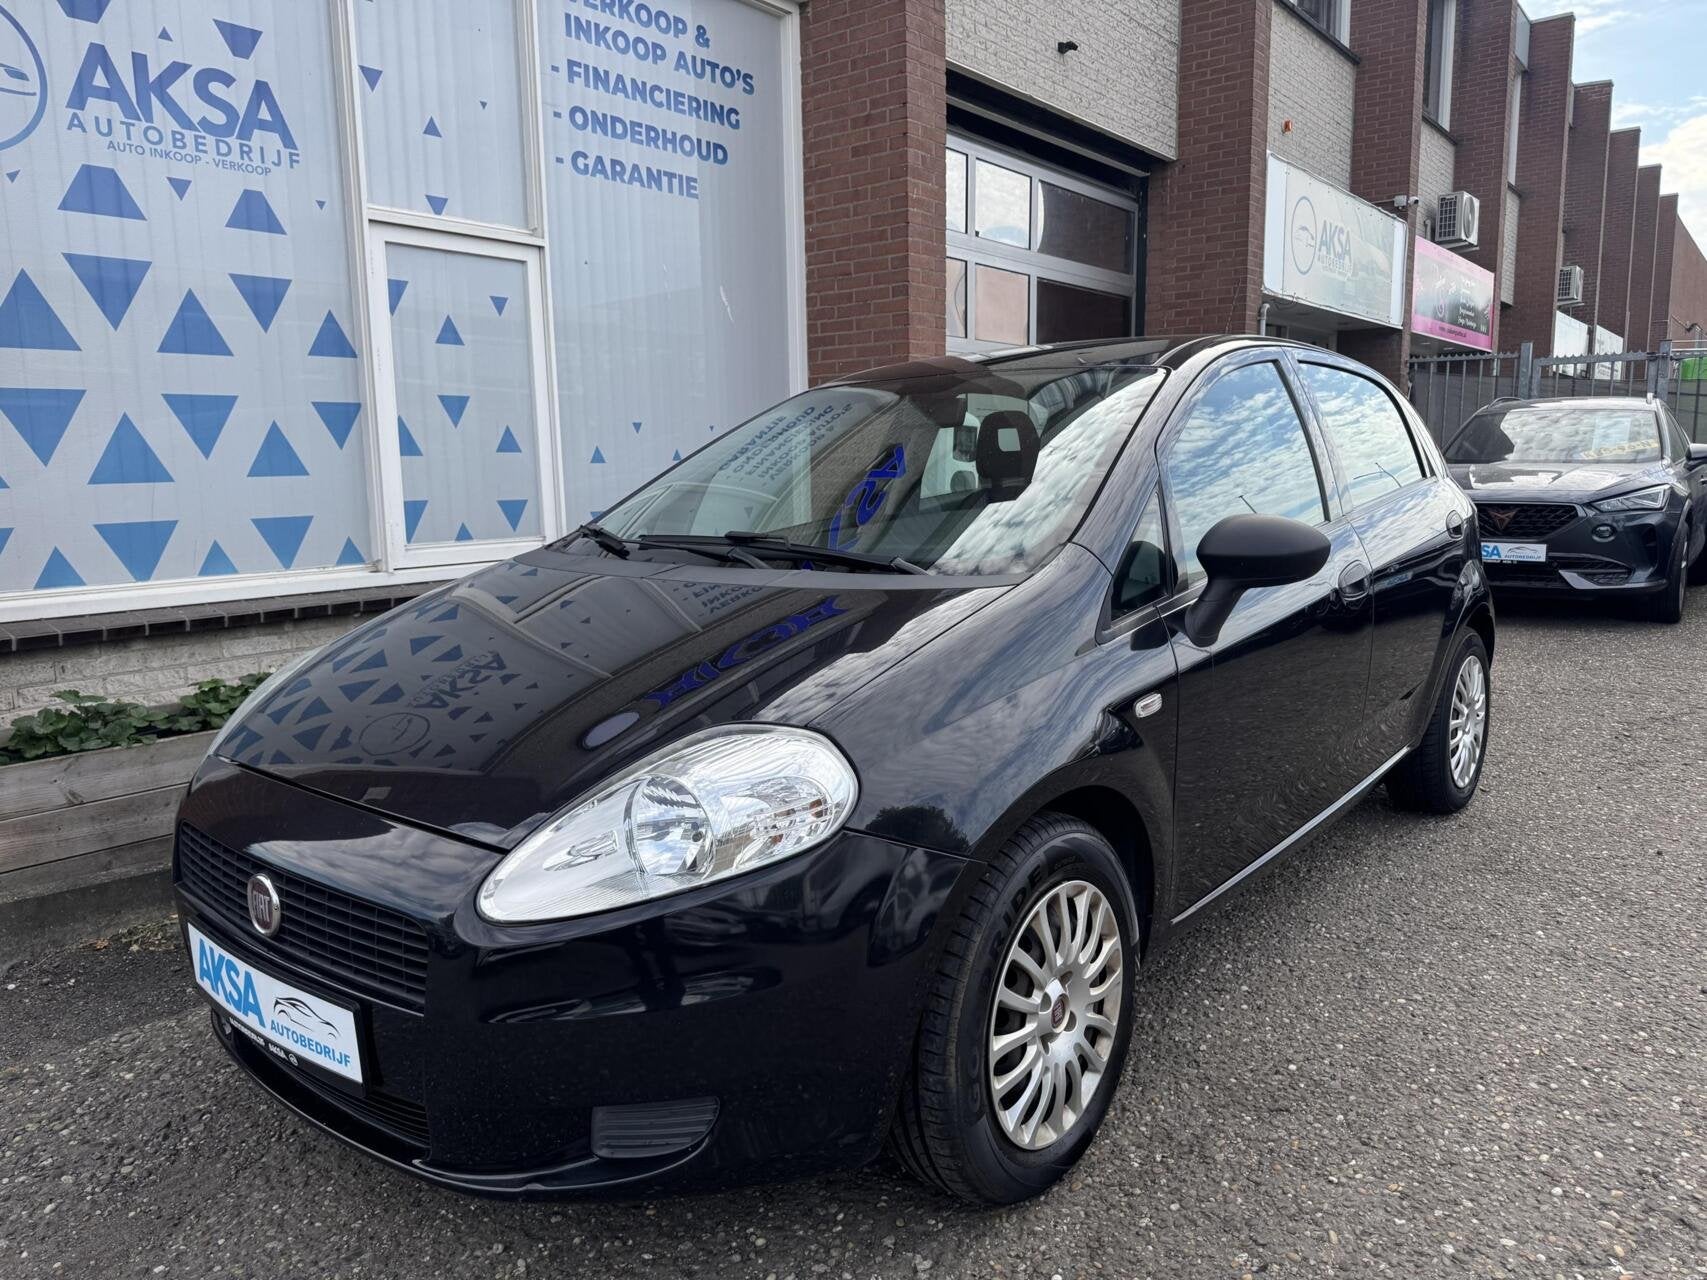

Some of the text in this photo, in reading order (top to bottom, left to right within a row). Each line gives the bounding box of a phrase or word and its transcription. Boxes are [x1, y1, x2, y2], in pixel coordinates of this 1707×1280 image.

[569, 0, 711, 49] RKOOP &
[564, 12, 755, 95] INKOOP AUTO'S
[65, 41, 299, 151] AKSA
[567, 59, 741, 130] FINANCIERING
[66, 111, 301, 170] AUTOBEDRIJF
[106, 139, 146, 156] AUTO
[149, 147, 202, 165] INKOOP
[212, 157, 272, 177] VERKOOP
[569, 105, 729, 166] ONDERHOUD
[571, 150, 699, 200] GARANTIE
[1318, 219, 1353, 263] AKSA
[252, 889, 271, 923] FIAT
[199, 937, 266, 1029] AKSA
[270, 1019, 351, 1068] AUTOBEDRIJF
